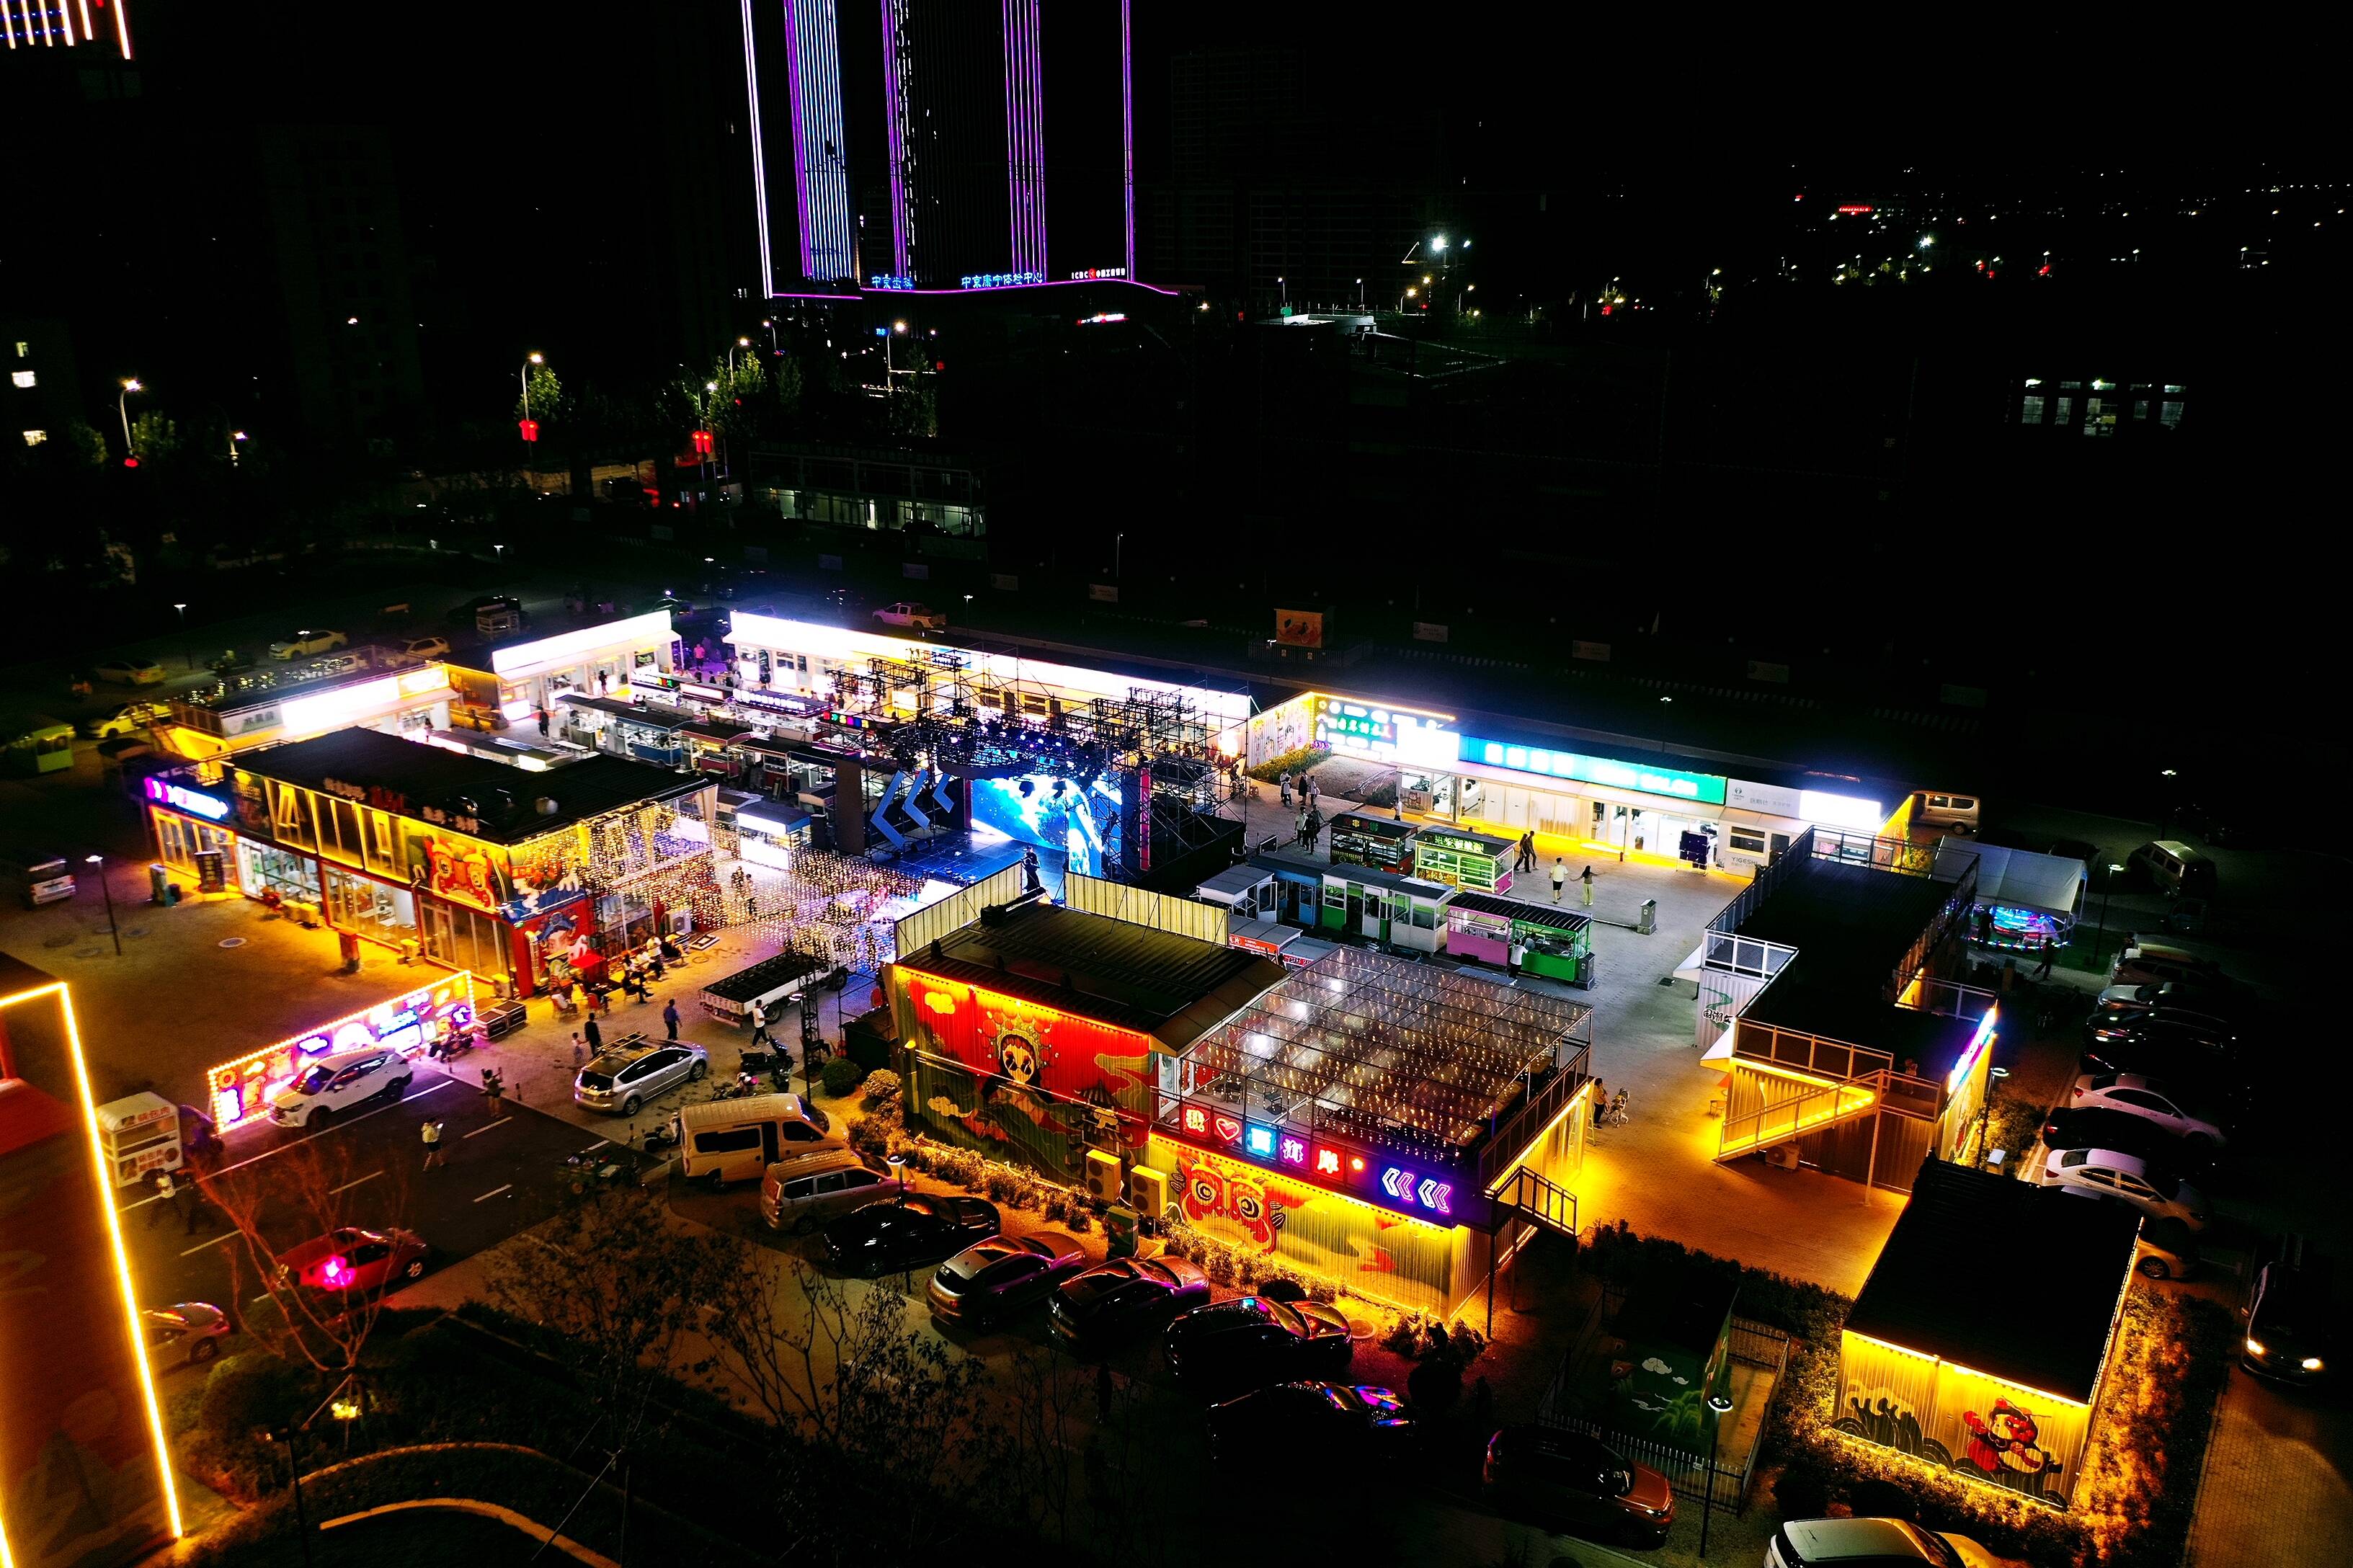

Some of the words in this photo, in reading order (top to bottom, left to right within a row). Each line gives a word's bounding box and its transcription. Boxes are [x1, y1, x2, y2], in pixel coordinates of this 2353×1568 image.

[961, 272, 1043, 289] 中京康宁体检中心
[1072, 271, 1089, 280] ICBC
